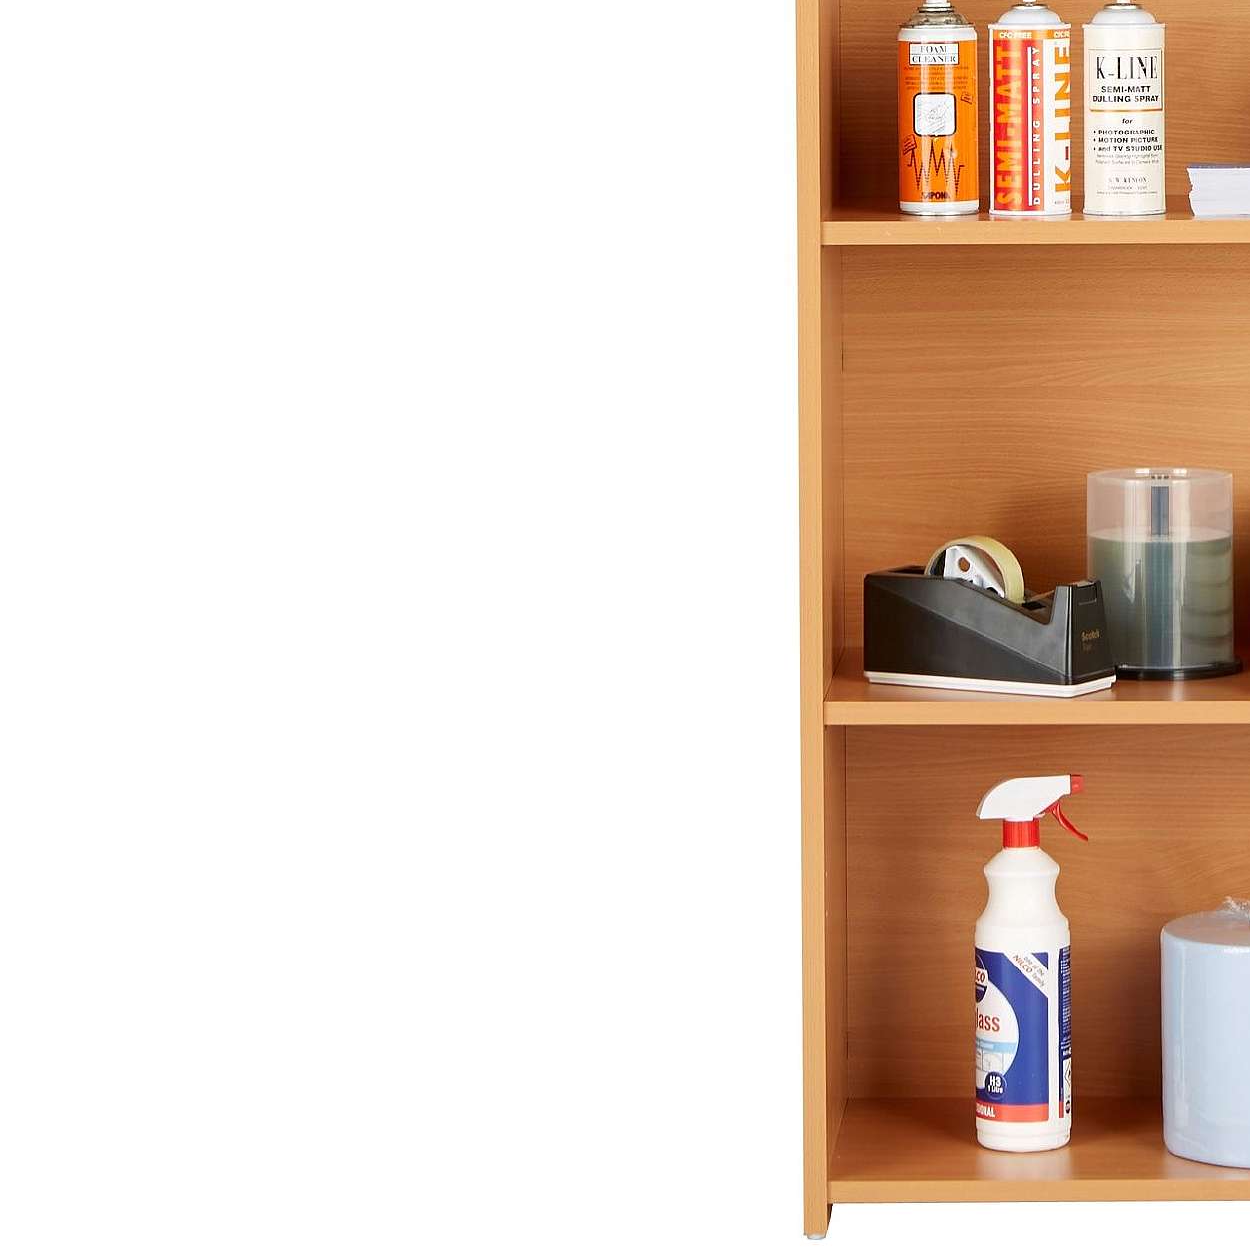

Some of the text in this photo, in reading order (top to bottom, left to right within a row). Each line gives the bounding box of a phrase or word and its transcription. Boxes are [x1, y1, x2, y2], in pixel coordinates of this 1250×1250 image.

[1096, 56, 1158, 80] K-LINE
[1092, 95, 1159, 103] DULLING SPRAY
[996, 45, 1023, 206] SEMI-MATT
[1033, 46, 1041, 206] DULLING SPRAY
[1054, 46, 1071, 194] K-LINE
[1013, 955, 1032, 974] NILCO
[989, 1075, 1002, 1087] H3
